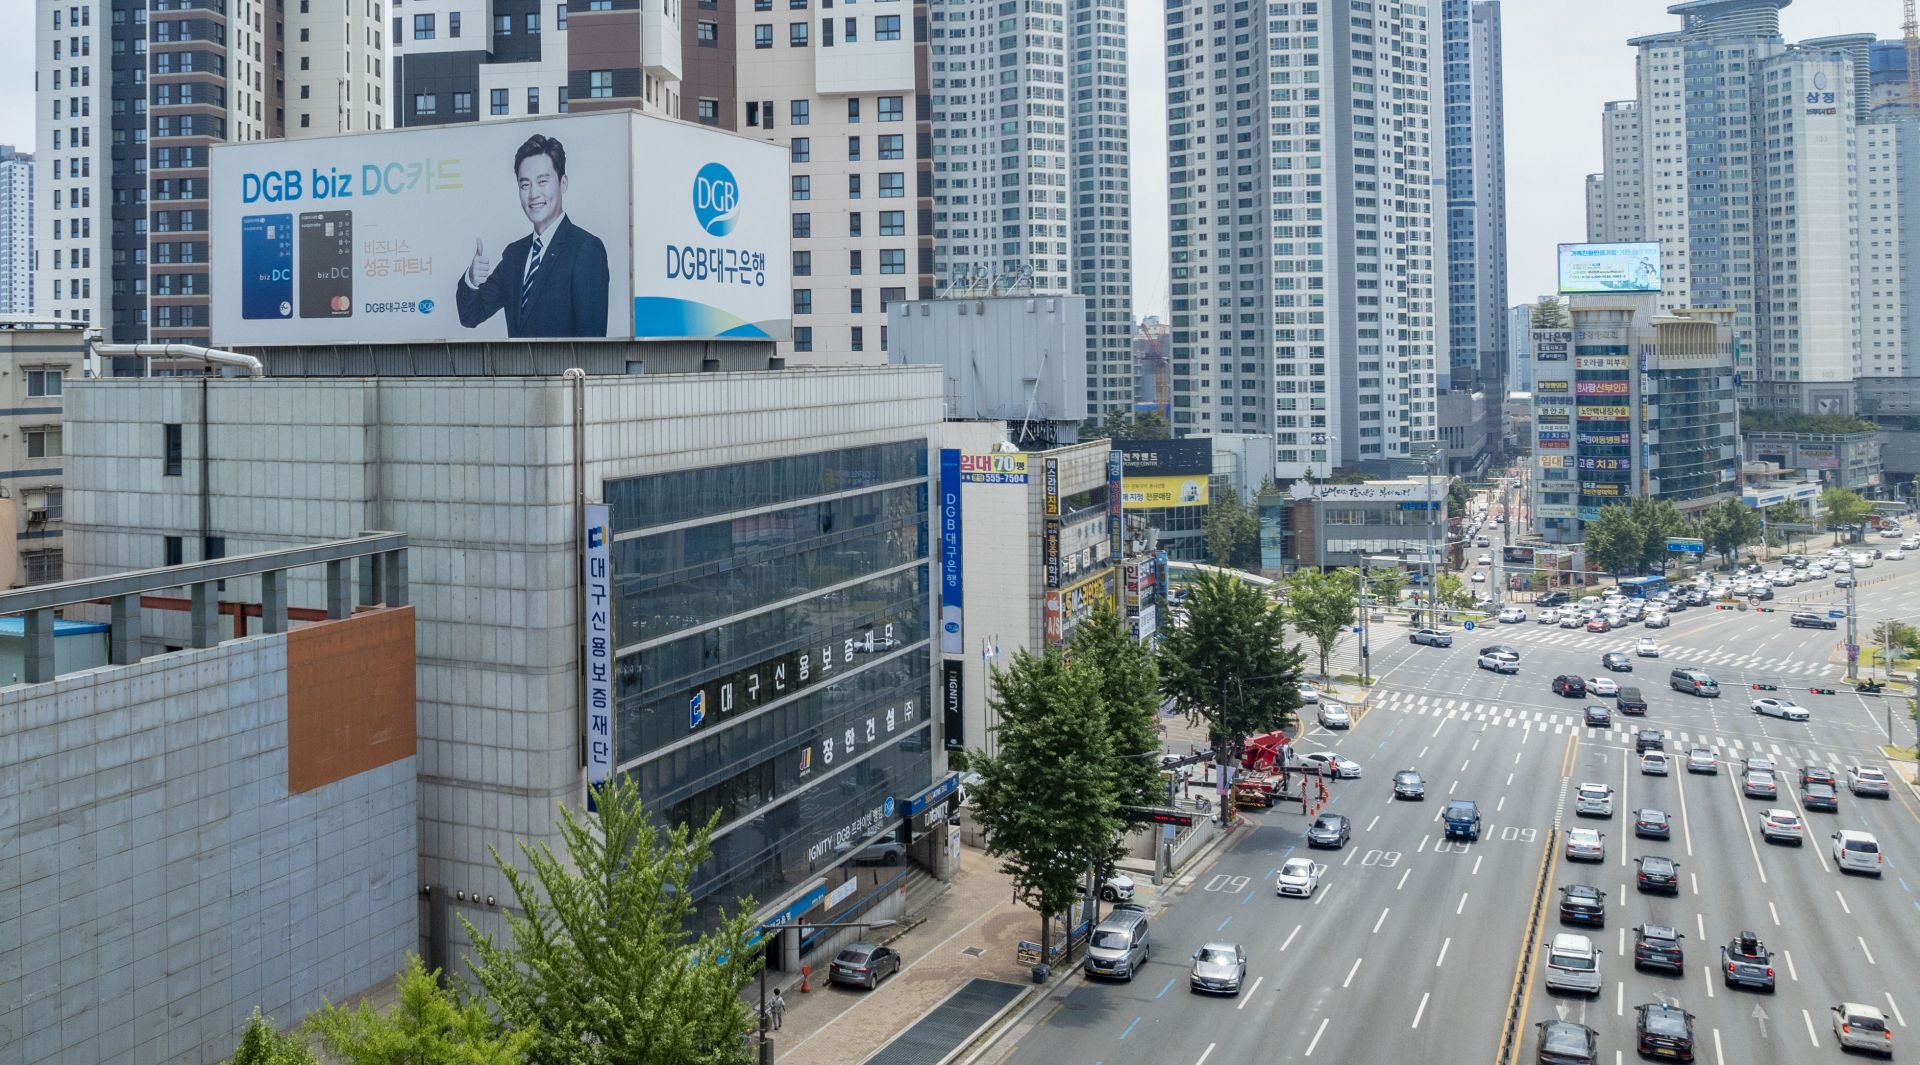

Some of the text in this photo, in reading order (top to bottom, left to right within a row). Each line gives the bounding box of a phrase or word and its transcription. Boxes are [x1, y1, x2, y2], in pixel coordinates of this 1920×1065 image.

[242, 158, 464, 203] DGB biz DC카드
[698, 176, 735, 212] DGB
[364, 239, 410, 256] 비즈니스
[259, 269, 291, 281] biz DC
[317, 267, 349, 279] biz DC
[364, 256, 432, 277] 성공 파트너
[667, 244, 765, 287] DGB대구은행
[365, 301, 416, 313] DGB대구은행
[961, 455, 992, 471] 임대
[985, 474, 1025, 483] 555-7504
[945, 493, 957, 587] DGB대구은행
[590, 557, 609, 765] 대구신용보증재단
[836, 825, 851, 845] DGB
